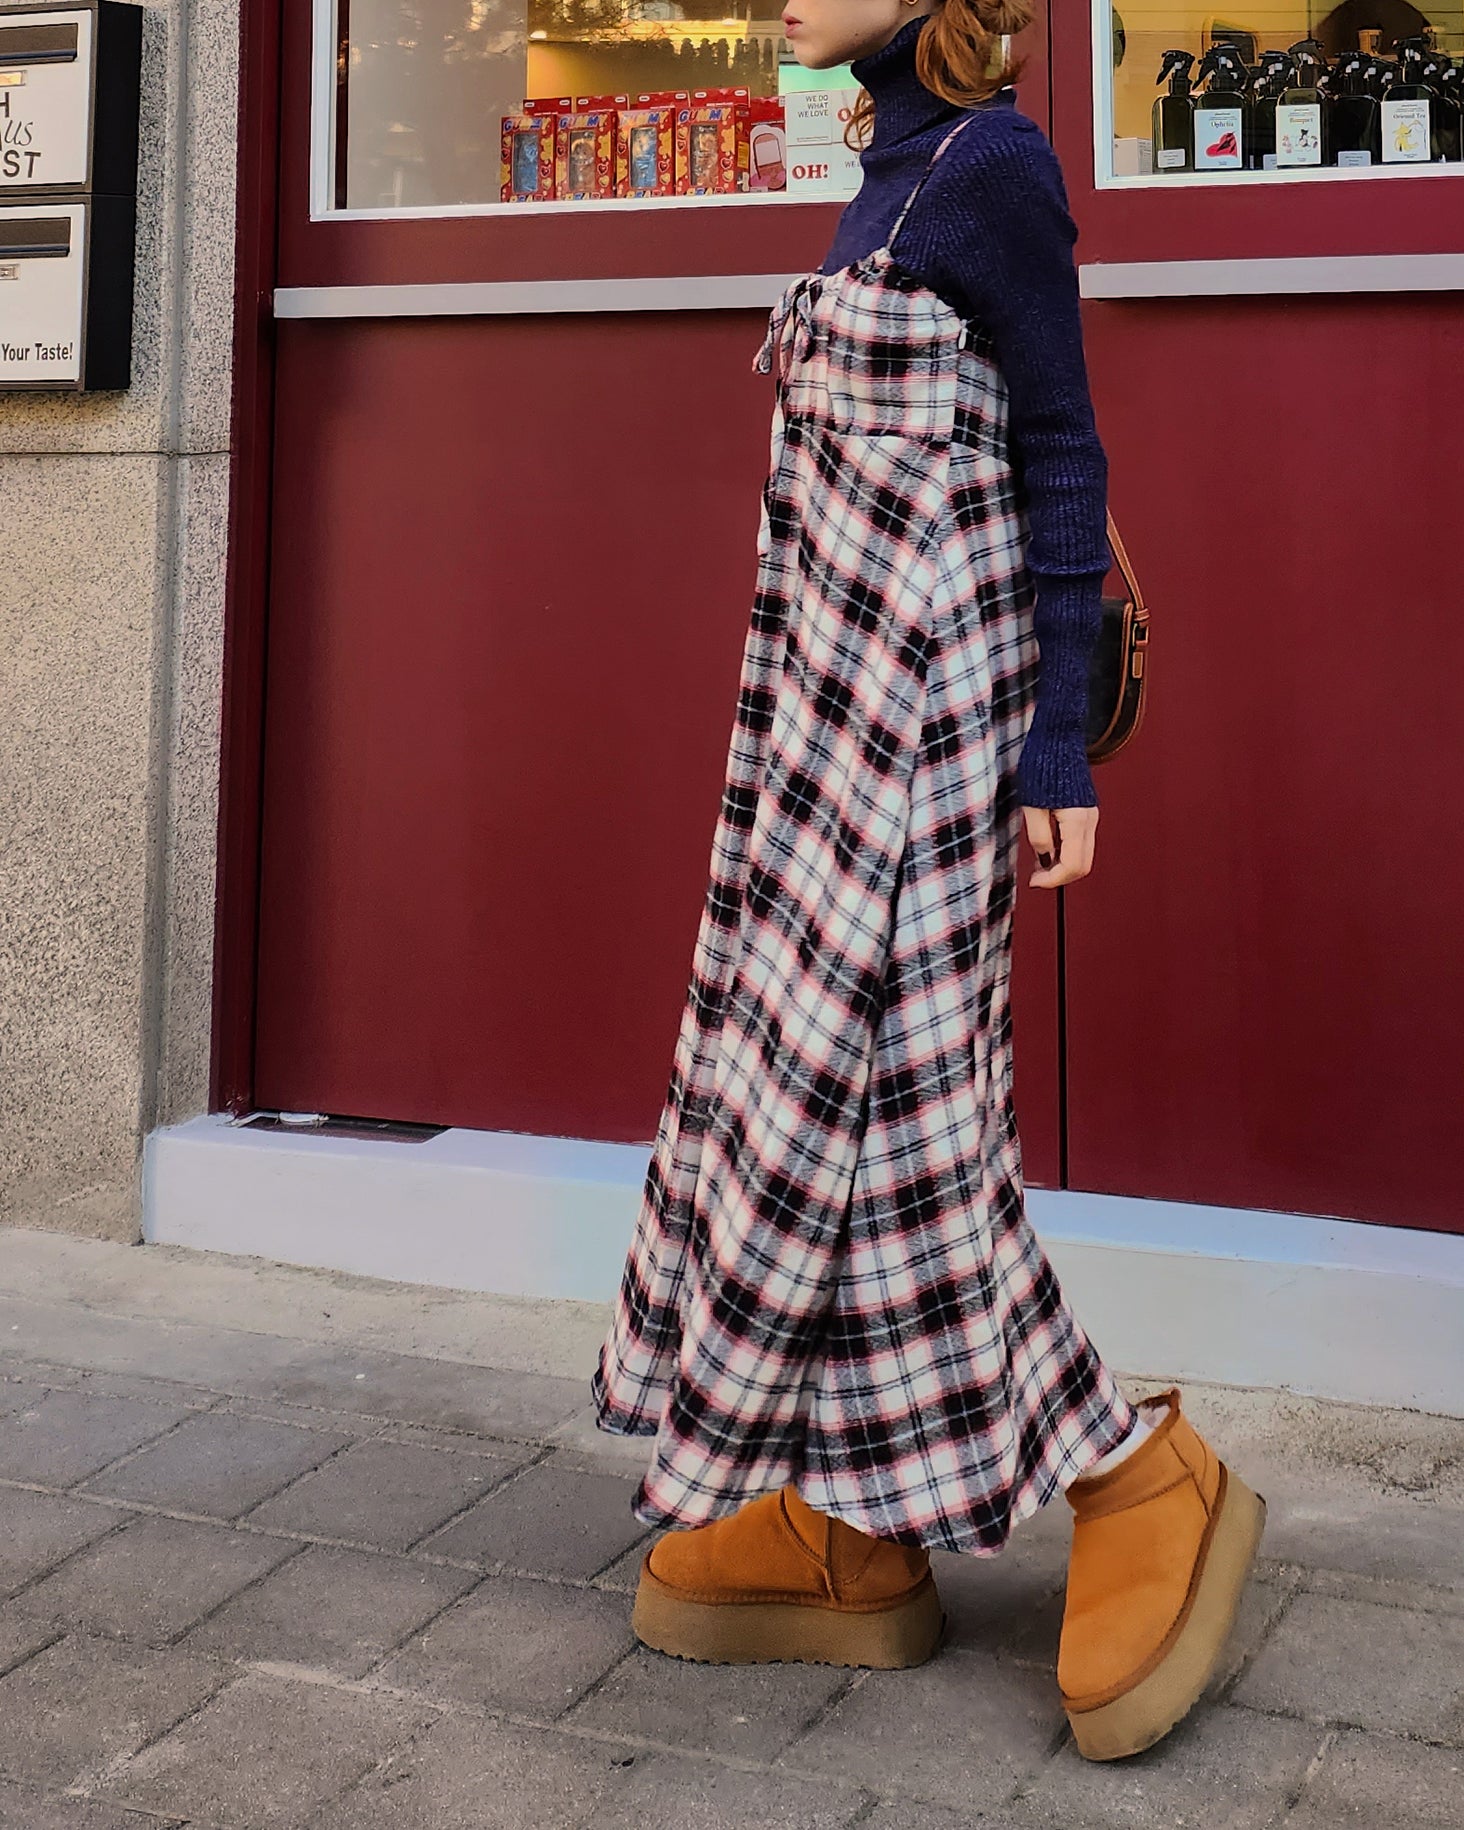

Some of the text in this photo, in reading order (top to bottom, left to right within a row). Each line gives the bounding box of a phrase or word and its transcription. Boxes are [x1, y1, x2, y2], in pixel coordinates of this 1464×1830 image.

[818, 94, 829, 102] DO
[807, 102, 829, 110] WHAT
[810, 109, 829, 117] LOVE
[791, 164, 829, 179] OH!
[1, 341, 74, 361] Your Taste!
